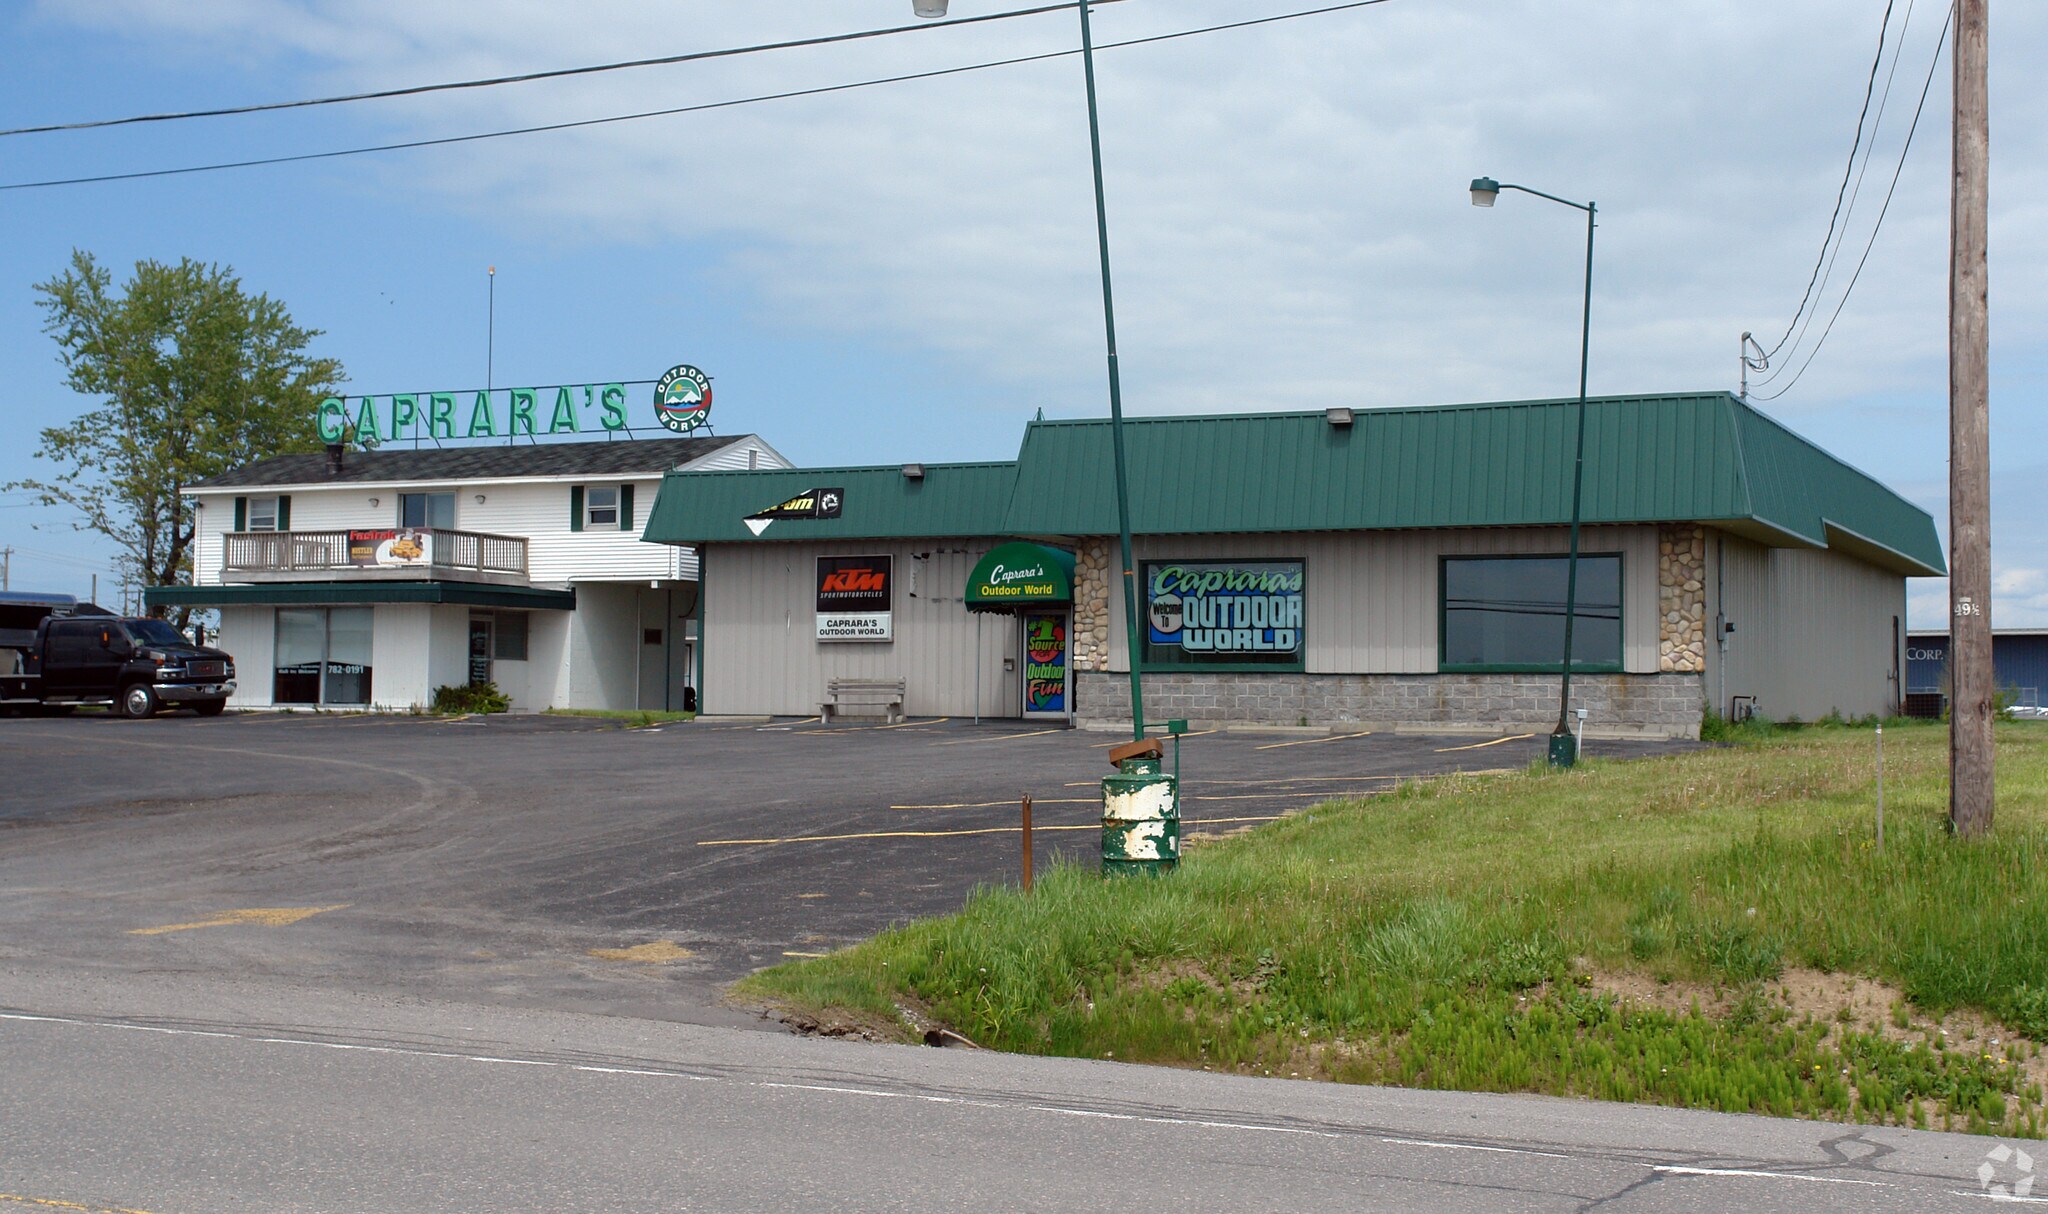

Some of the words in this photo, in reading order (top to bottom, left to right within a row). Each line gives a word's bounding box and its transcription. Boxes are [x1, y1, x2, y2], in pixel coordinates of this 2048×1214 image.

[657, 366, 709, 393] OUTDOOR
[317, 383, 629, 444] CAPRARA'S
[659, 409, 707, 431] WORLD
[821, 568, 886, 592] KTM
[990, 563, 1044, 585] Caprara's
[981, 585, 1021, 596] Outdoor
[1024, 584, 1053, 595] World
[1152, 602, 1183, 615] Welcome
[1182, 595, 1303, 629] OUTDOOR
[826, 619, 878, 628] CAPRARA'S
[1161, 615, 1170, 628] To
[819, 628, 856, 636] OUTDOOR
[857, 628, 885, 636] WORLD
[1182, 629, 1296, 650] WORLD
[1029, 636, 1065, 651] Source
[328, 664, 364, 674] 782-0191
[1027, 663, 1065, 680] Outdoor
[1029, 679, 1063, 704] Fun
